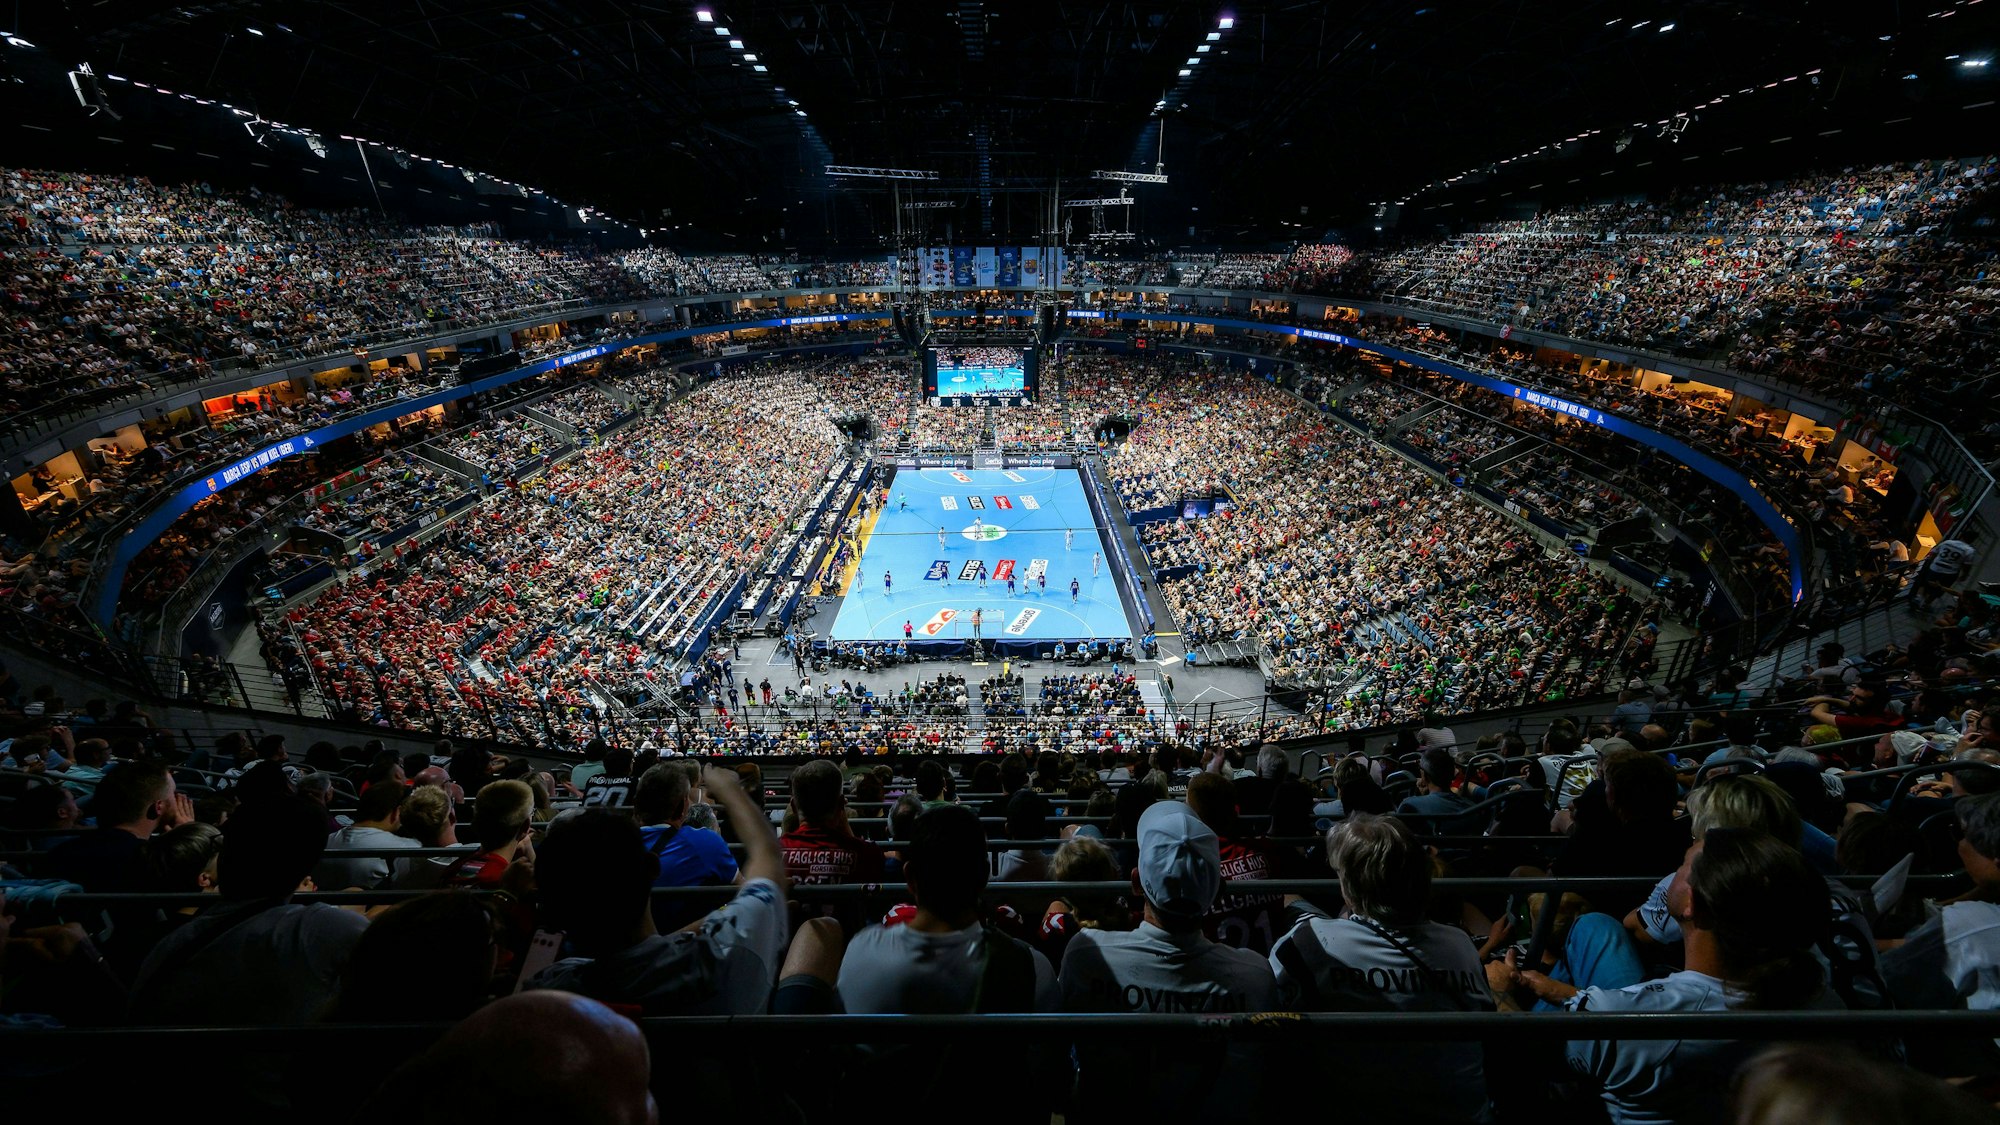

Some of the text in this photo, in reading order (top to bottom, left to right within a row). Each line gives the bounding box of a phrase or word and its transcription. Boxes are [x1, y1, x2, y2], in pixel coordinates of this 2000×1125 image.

[1526, 391, 1540, 404] BARÇA
[1550, 398, 1558, 409] VS
[1557, 400, 1569, 412] THW
[1568, 403, 1578, 415] KIEL
[222, 466, 241, 483] BARÇA
[251, 456, 260, 469] VS
[257, 451, 270, 466] THW
[268, 447, 280, 460] KIEL
[278, 441, 295, 456] (GER)
[954, 458, 967, 466] play
[1042, 458, 1055, 466] play
[1011, 609, 1036, 633] gorenje
[584, 786, 629, 808] 20
[788, 850, 831, 864] FAGLIGE
[833, 851, 855, 865] HUS
[1246, 855, 1267, 871] HUS
[1217, 910, 1274, 949] 21
